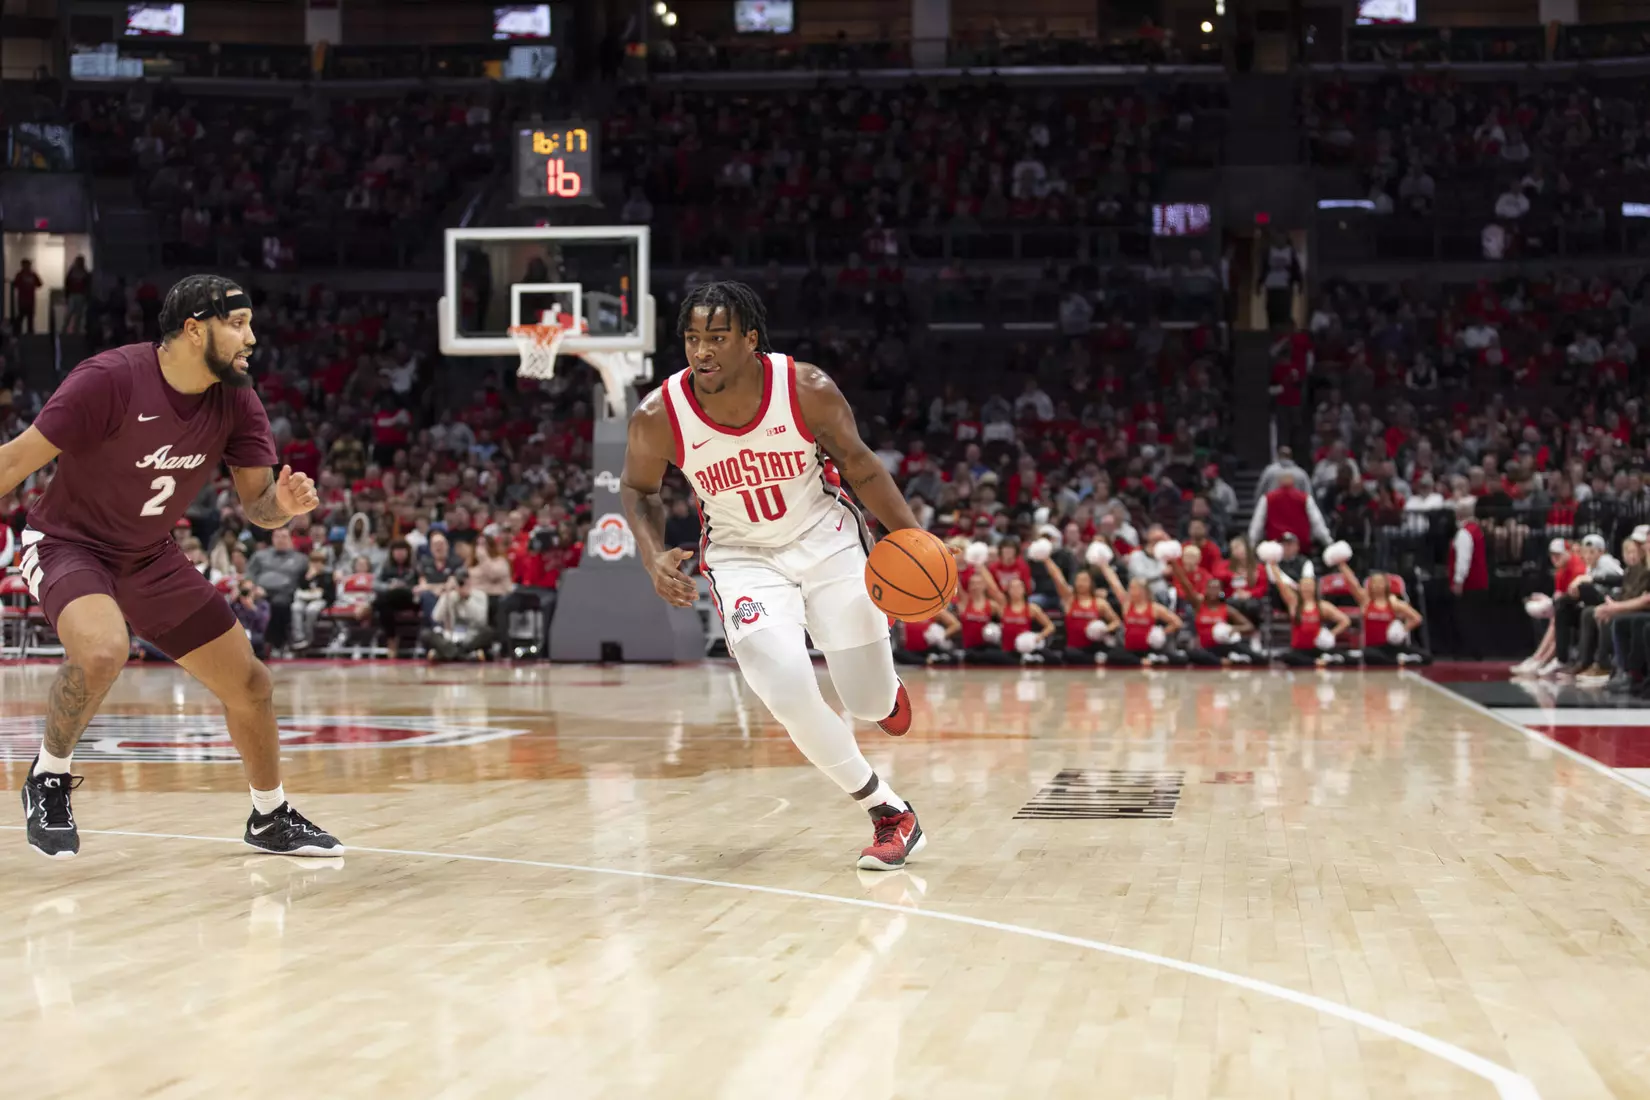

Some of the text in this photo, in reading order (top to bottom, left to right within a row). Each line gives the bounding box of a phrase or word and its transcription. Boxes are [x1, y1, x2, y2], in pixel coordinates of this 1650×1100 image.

[533, 128, 588, 154] 16:17
[547, 157, 581, 197] 16
[140, 475, 176, 517] 2
[736, 484, 788, 523] 10
